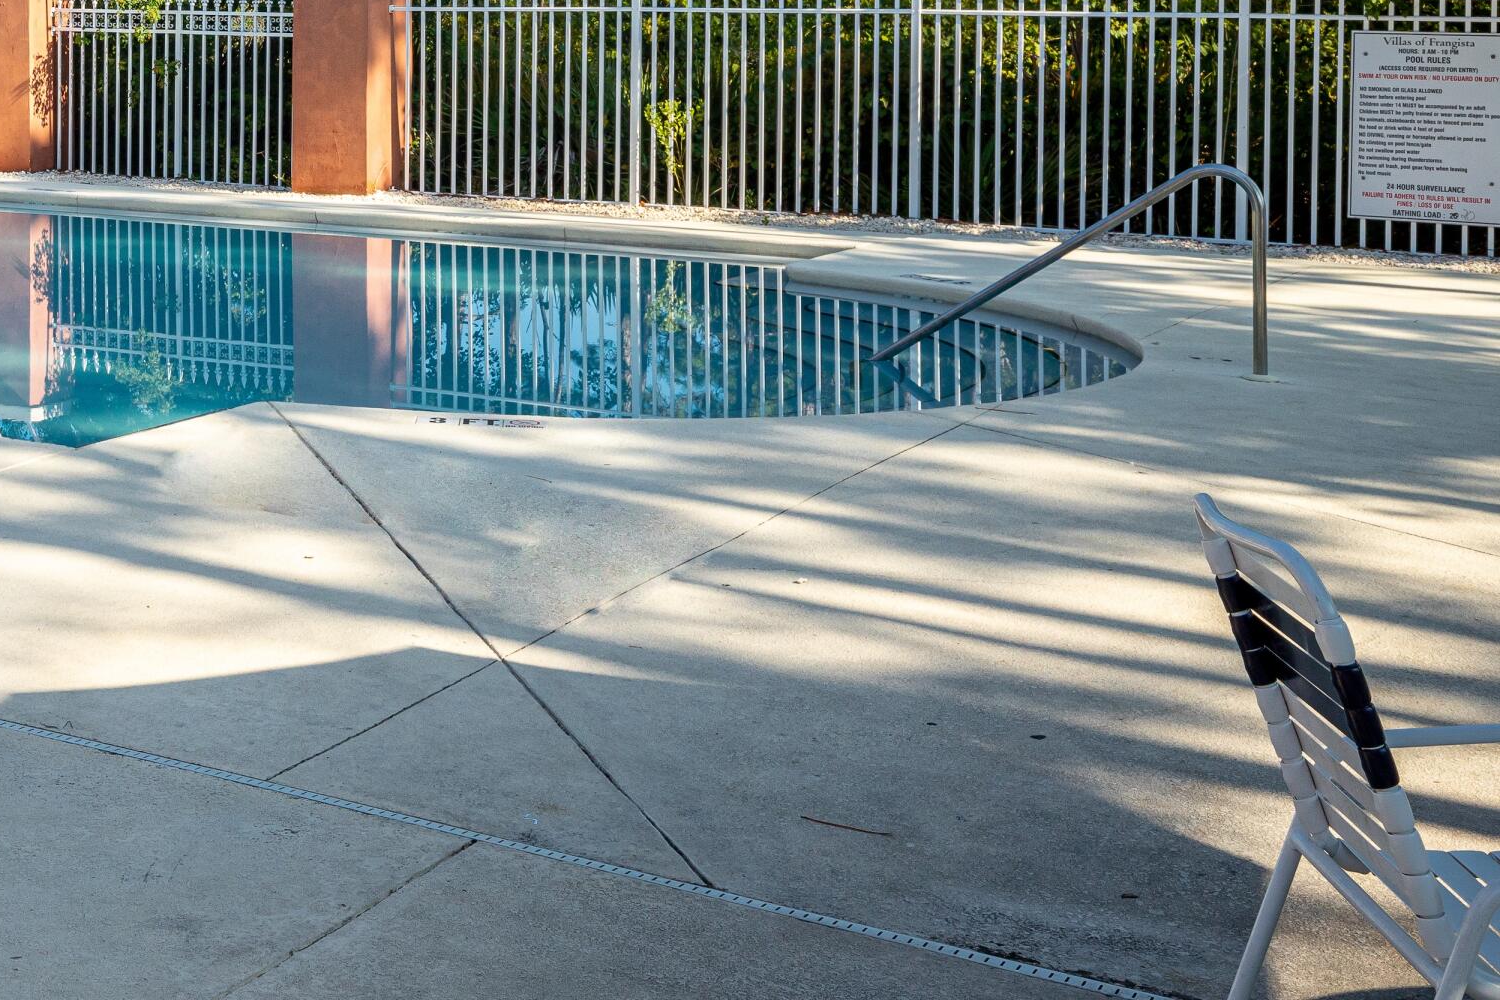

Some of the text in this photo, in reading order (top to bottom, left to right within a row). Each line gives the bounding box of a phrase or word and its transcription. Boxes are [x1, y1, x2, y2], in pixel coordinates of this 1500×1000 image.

[1383, 36, 1475, 49] Villas of Frangista
[1405, 56, 1451, 64] POOL RULES
[1386, 182, 1466, 194] 24 HOUR SURVEILLANCE
[1361, 191, 1385, 199] FAILURE
[1426, 194, 1445, 202] RULES
[1446, 195, 1461, 203] WILL
[1461, 196, 1484, 204] RESULT
[1484, 197, 1492, 205] IN
[1396, 200, 1413, 208] FINES
[1417, 201, 1433, 209] LOSS
[1392, 209, 1422, 218] BATHING
[1423, 211, 1442, 219] LOAD
